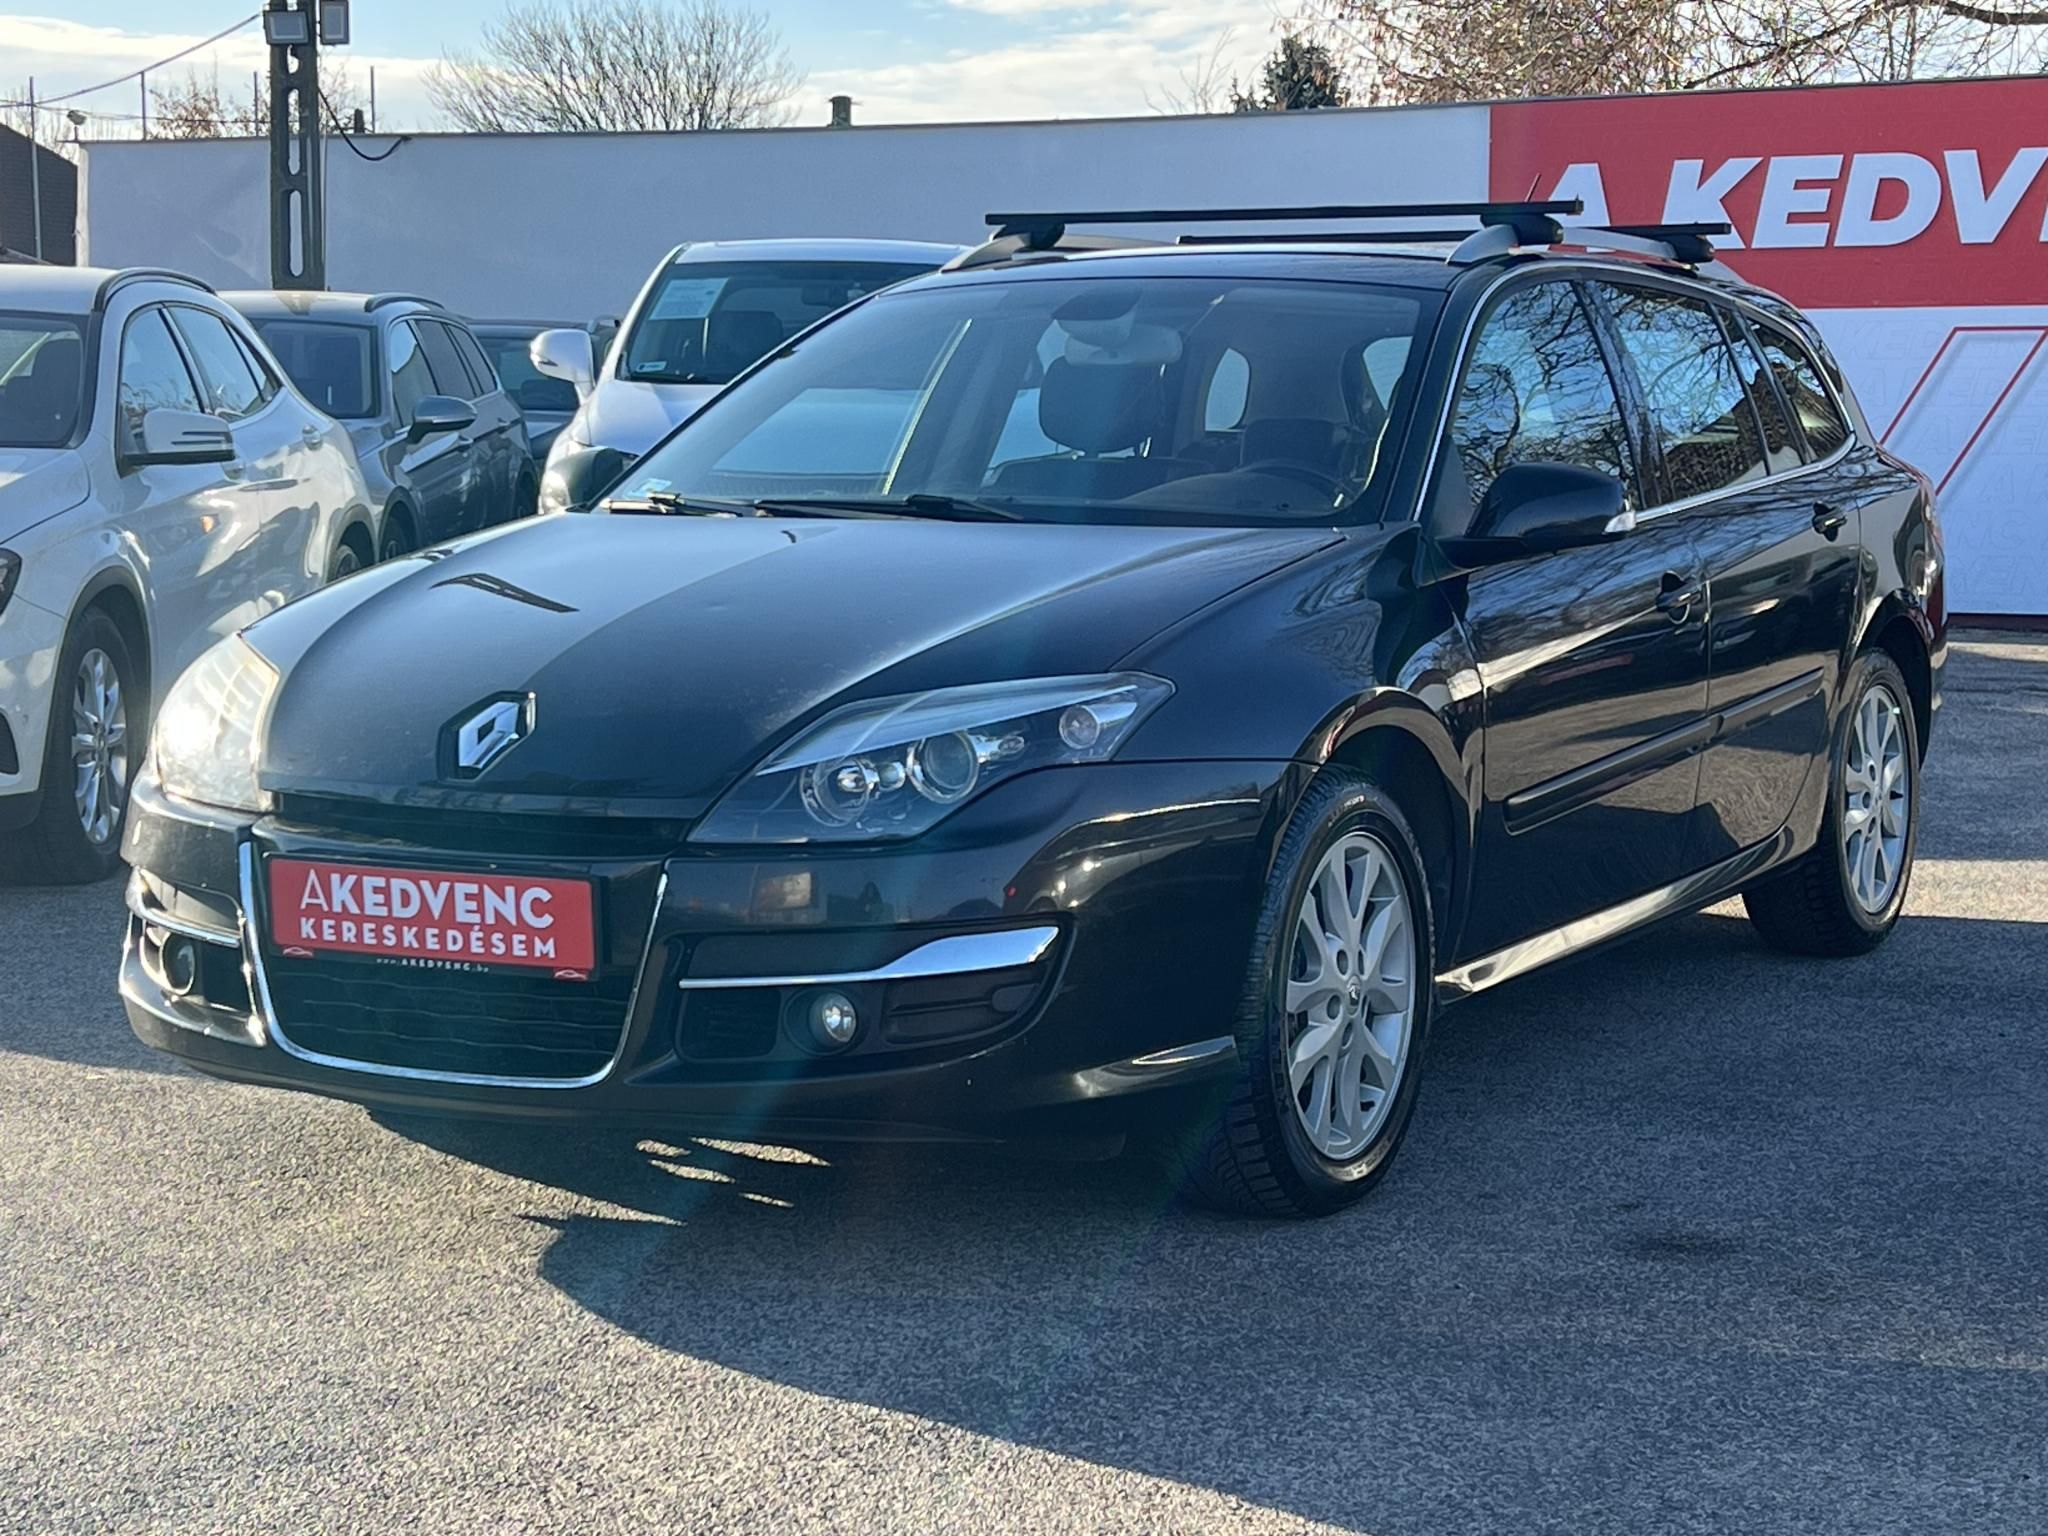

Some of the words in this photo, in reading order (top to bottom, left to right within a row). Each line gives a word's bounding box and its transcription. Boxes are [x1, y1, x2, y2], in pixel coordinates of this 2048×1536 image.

[1661, 147, 2048, 249] KEDV
[300, 868, 554, 929] AKEDVENC
[300, 917, 556, 959] KERESKEDÉSEM
